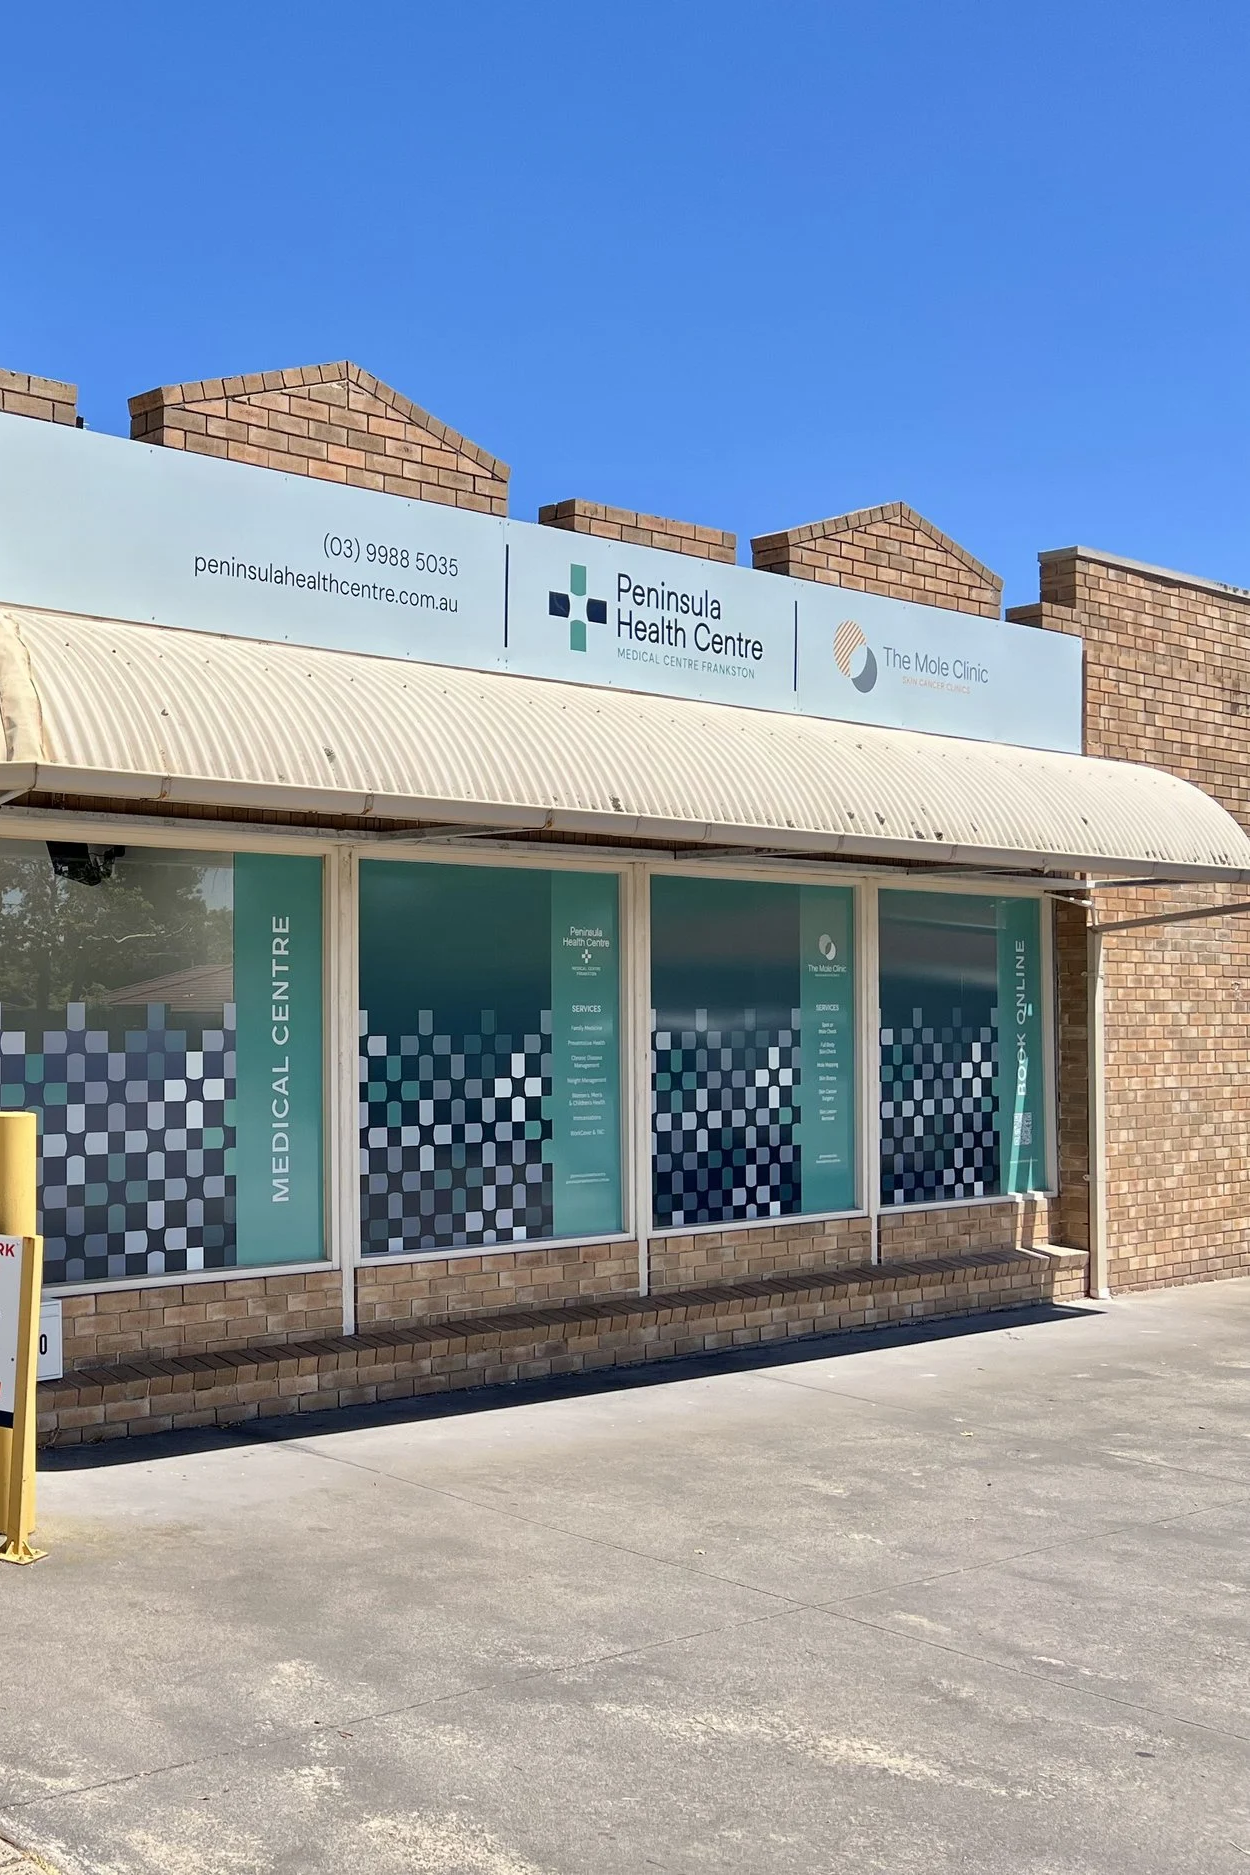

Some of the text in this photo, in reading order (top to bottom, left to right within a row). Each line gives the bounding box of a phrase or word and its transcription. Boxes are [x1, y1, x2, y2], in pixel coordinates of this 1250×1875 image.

[323, 532, 459, 577] (03) 9988 5035
[194, 555, 459, 614] peninsulahealthcentre.com.au
[617, 572, 721, 621] Peninsula
[617, 608, 764, 661] Health Centre
[617, 647, 755, 680] MEDICAL CENTRE FRANKSTON
[883, 646, 989, 684] The Mole Clinic
[902, 675, 918, 687] SKIN
[919, 678, 945, 691] CANCER
[562, 937, 610, 948] Health Centre
[570, 926, 603, 937] Peninsula
[808, 964, 819, 973] The
[832, 965, 847, 973] Clinic
[571, 1004, 602, 1013] SERVICES
[816, 1004, 840, 1012] SERVICES
[1015, 940, 1027, 1096] BOOK ONLINE
[271, 915, 290, 1203] MEDICAL CENTRE
